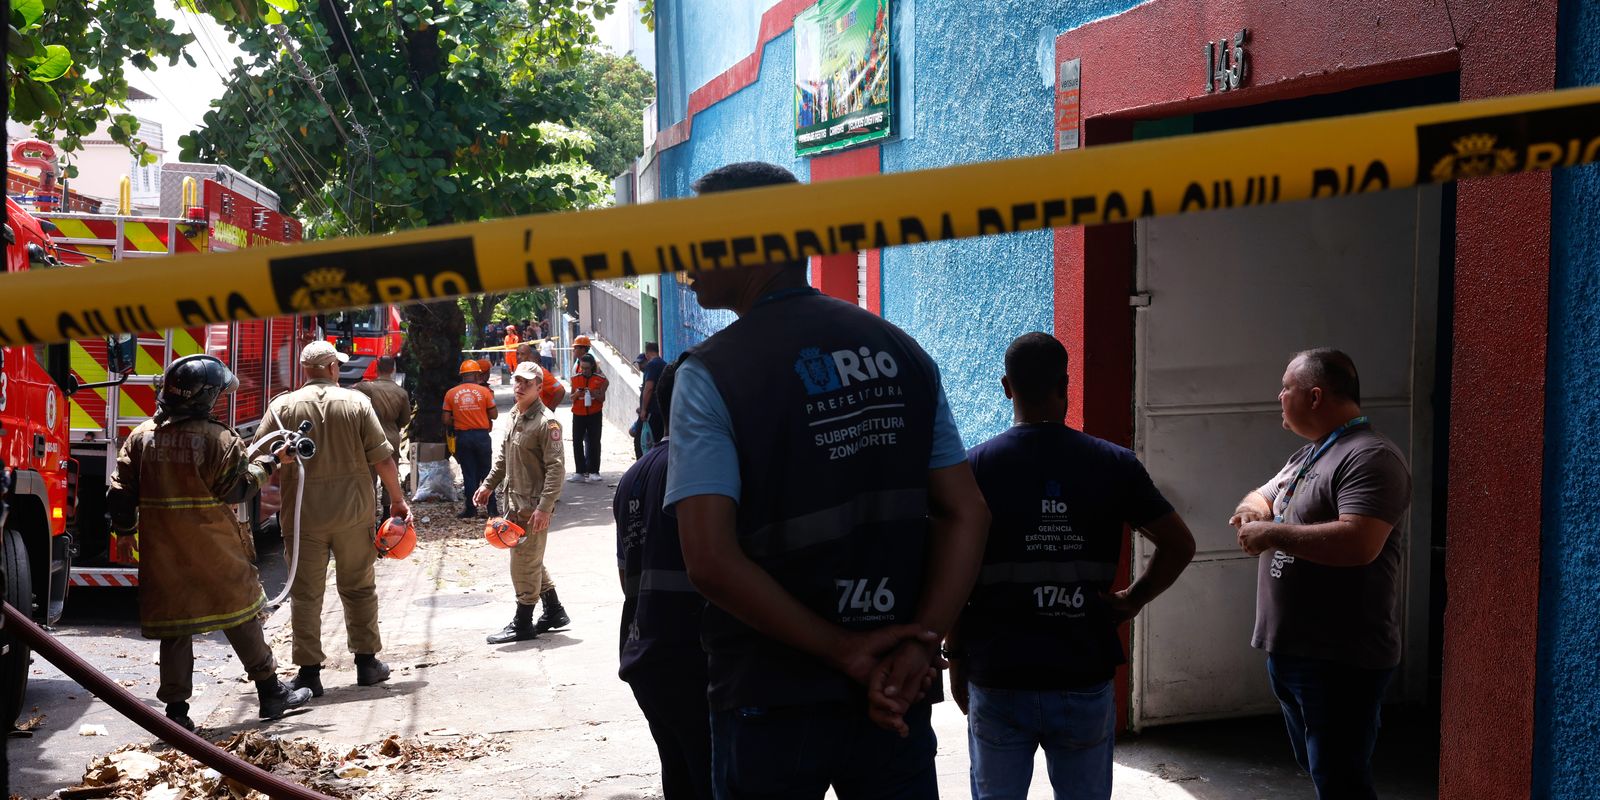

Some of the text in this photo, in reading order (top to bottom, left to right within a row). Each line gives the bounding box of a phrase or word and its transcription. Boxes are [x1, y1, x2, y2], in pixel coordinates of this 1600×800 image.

[1203, 27, 1248, 94] 145
[1524, 136, 1600, 171] RI
[831, 346, 899, 387] Rio
[806, 385, 903, 415] PREFEITURA
[1041, 499, 1068, 514] Rio
[832, 576, 896, 614] 746
[1032, 585, 1086, 609] 1746
